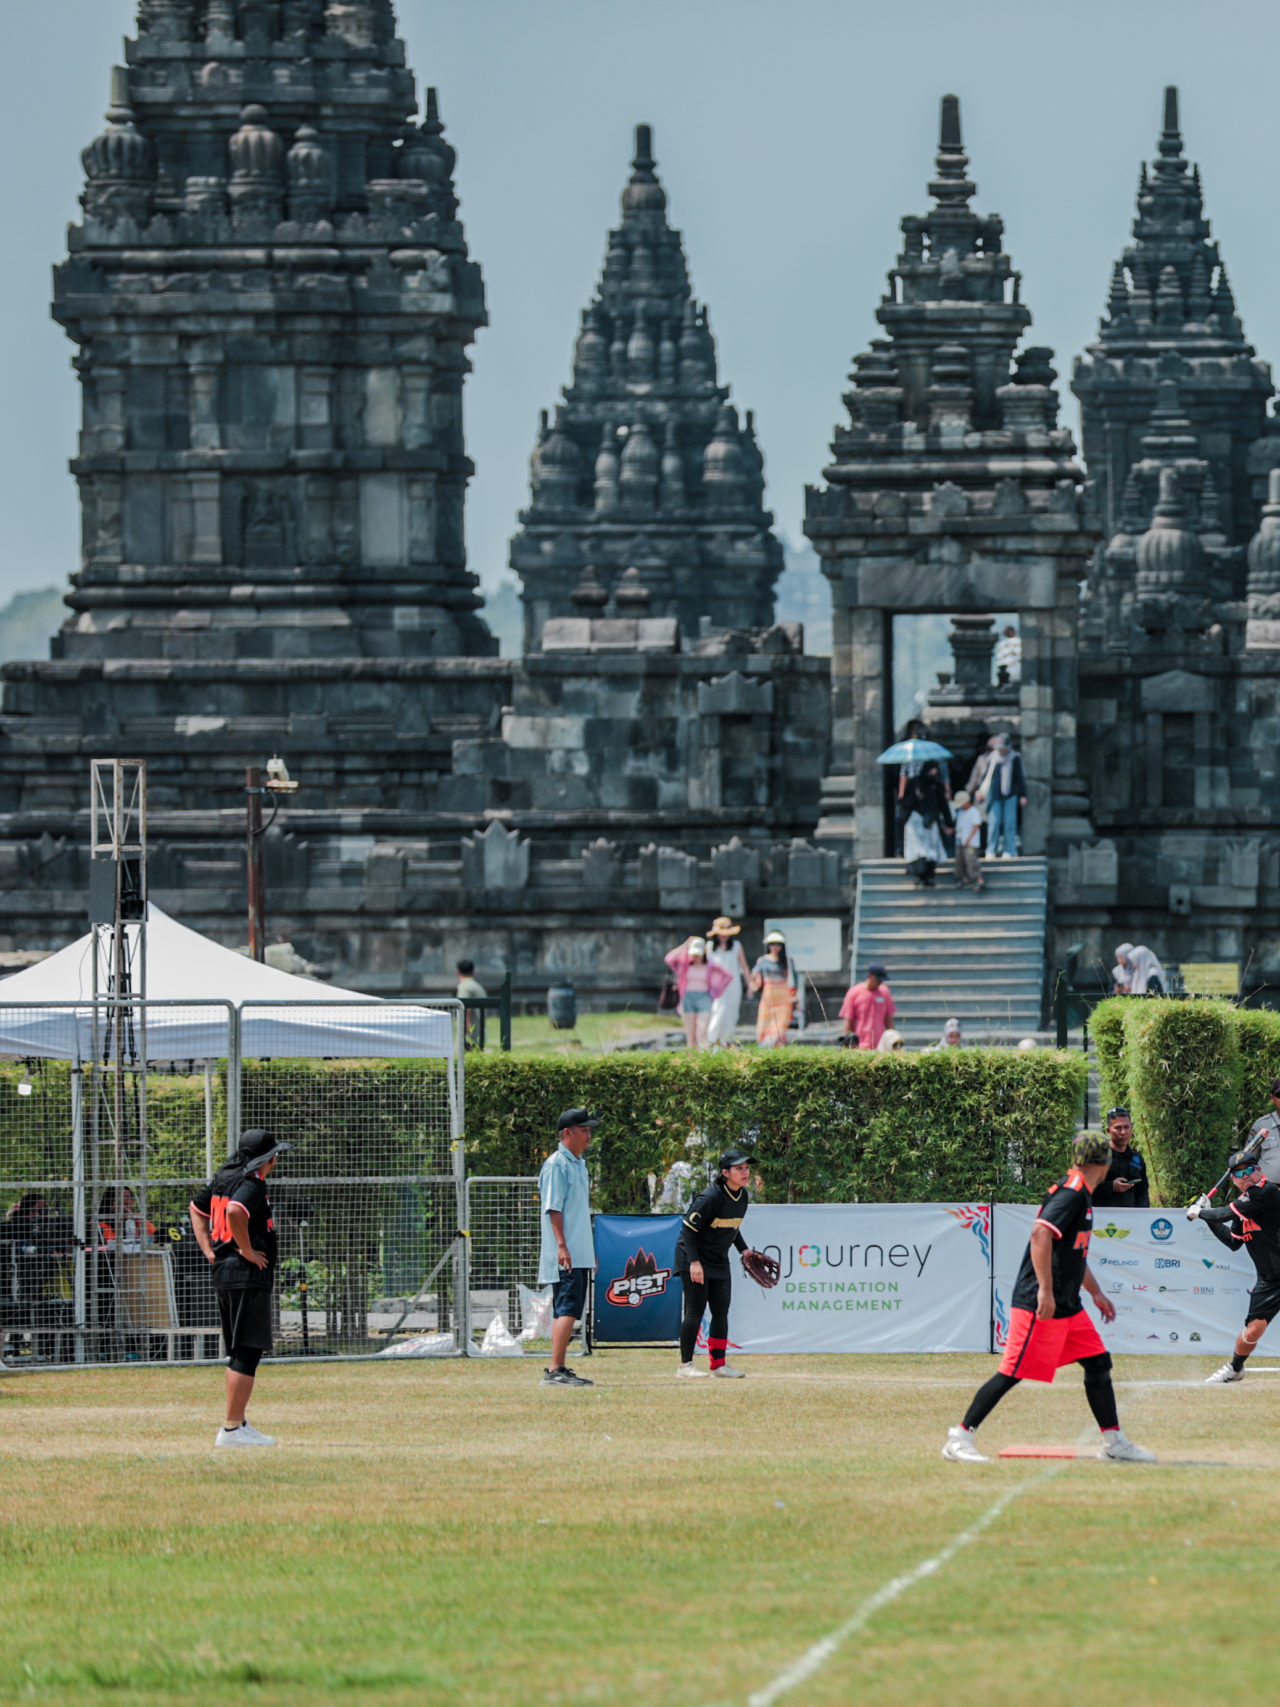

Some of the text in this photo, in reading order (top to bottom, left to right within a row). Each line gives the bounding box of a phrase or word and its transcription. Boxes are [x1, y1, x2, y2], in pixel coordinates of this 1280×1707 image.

[752, 1244, 932, 1278] njourney
[613, 1272, 668, 1295] PIST
[785, 1281, 899, 1293] DESTINATION
[782, 1299, 902, 1311] MANAGEMENT
